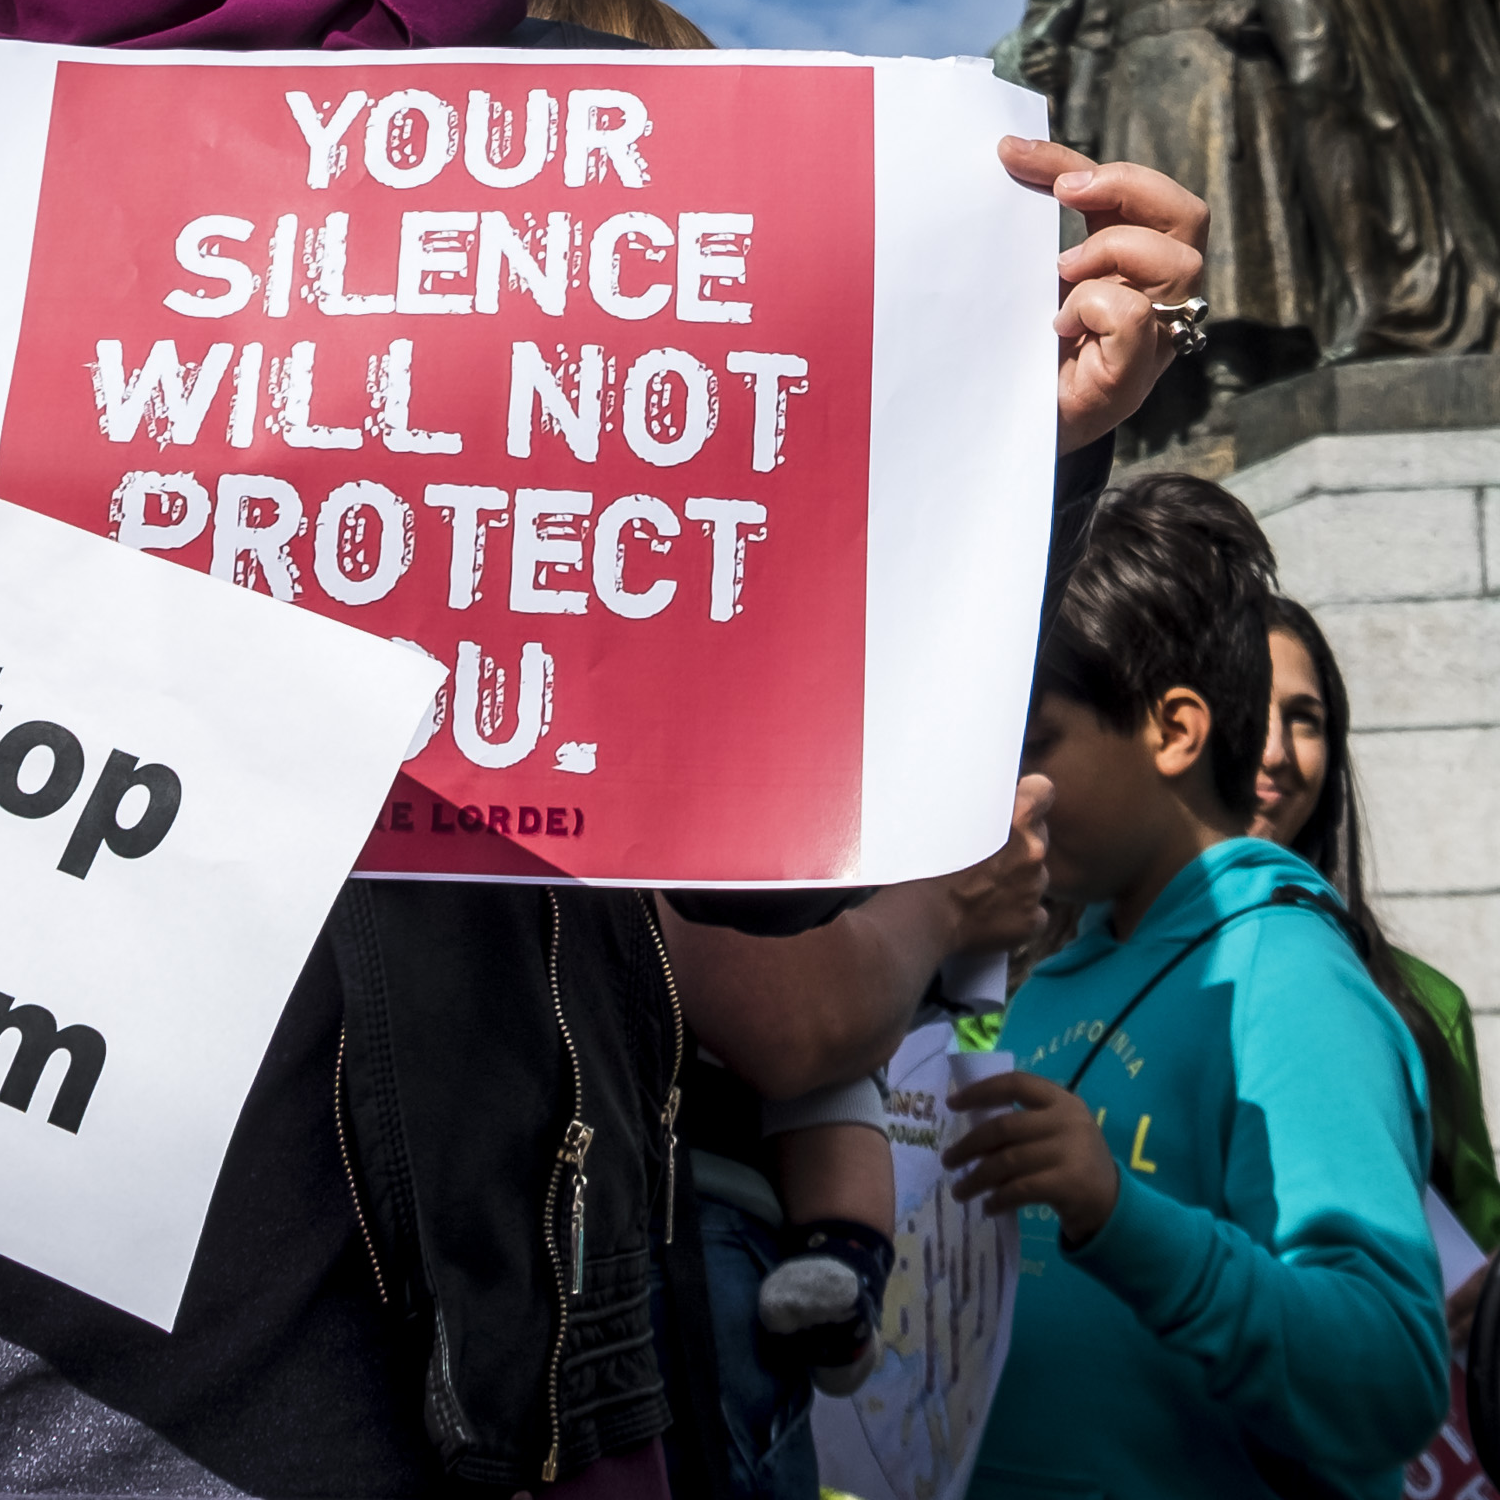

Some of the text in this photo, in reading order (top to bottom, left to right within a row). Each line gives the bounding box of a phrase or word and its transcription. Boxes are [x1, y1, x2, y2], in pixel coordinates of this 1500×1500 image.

[285, 88, 653, 190] YOUR
[163, 210, 754, 324] SILENCE
[84, 338, 808, 473] WILL NOT
[108, 470, 768, 623] PROTECT
[430, 802, 586, 838] LORDE)
